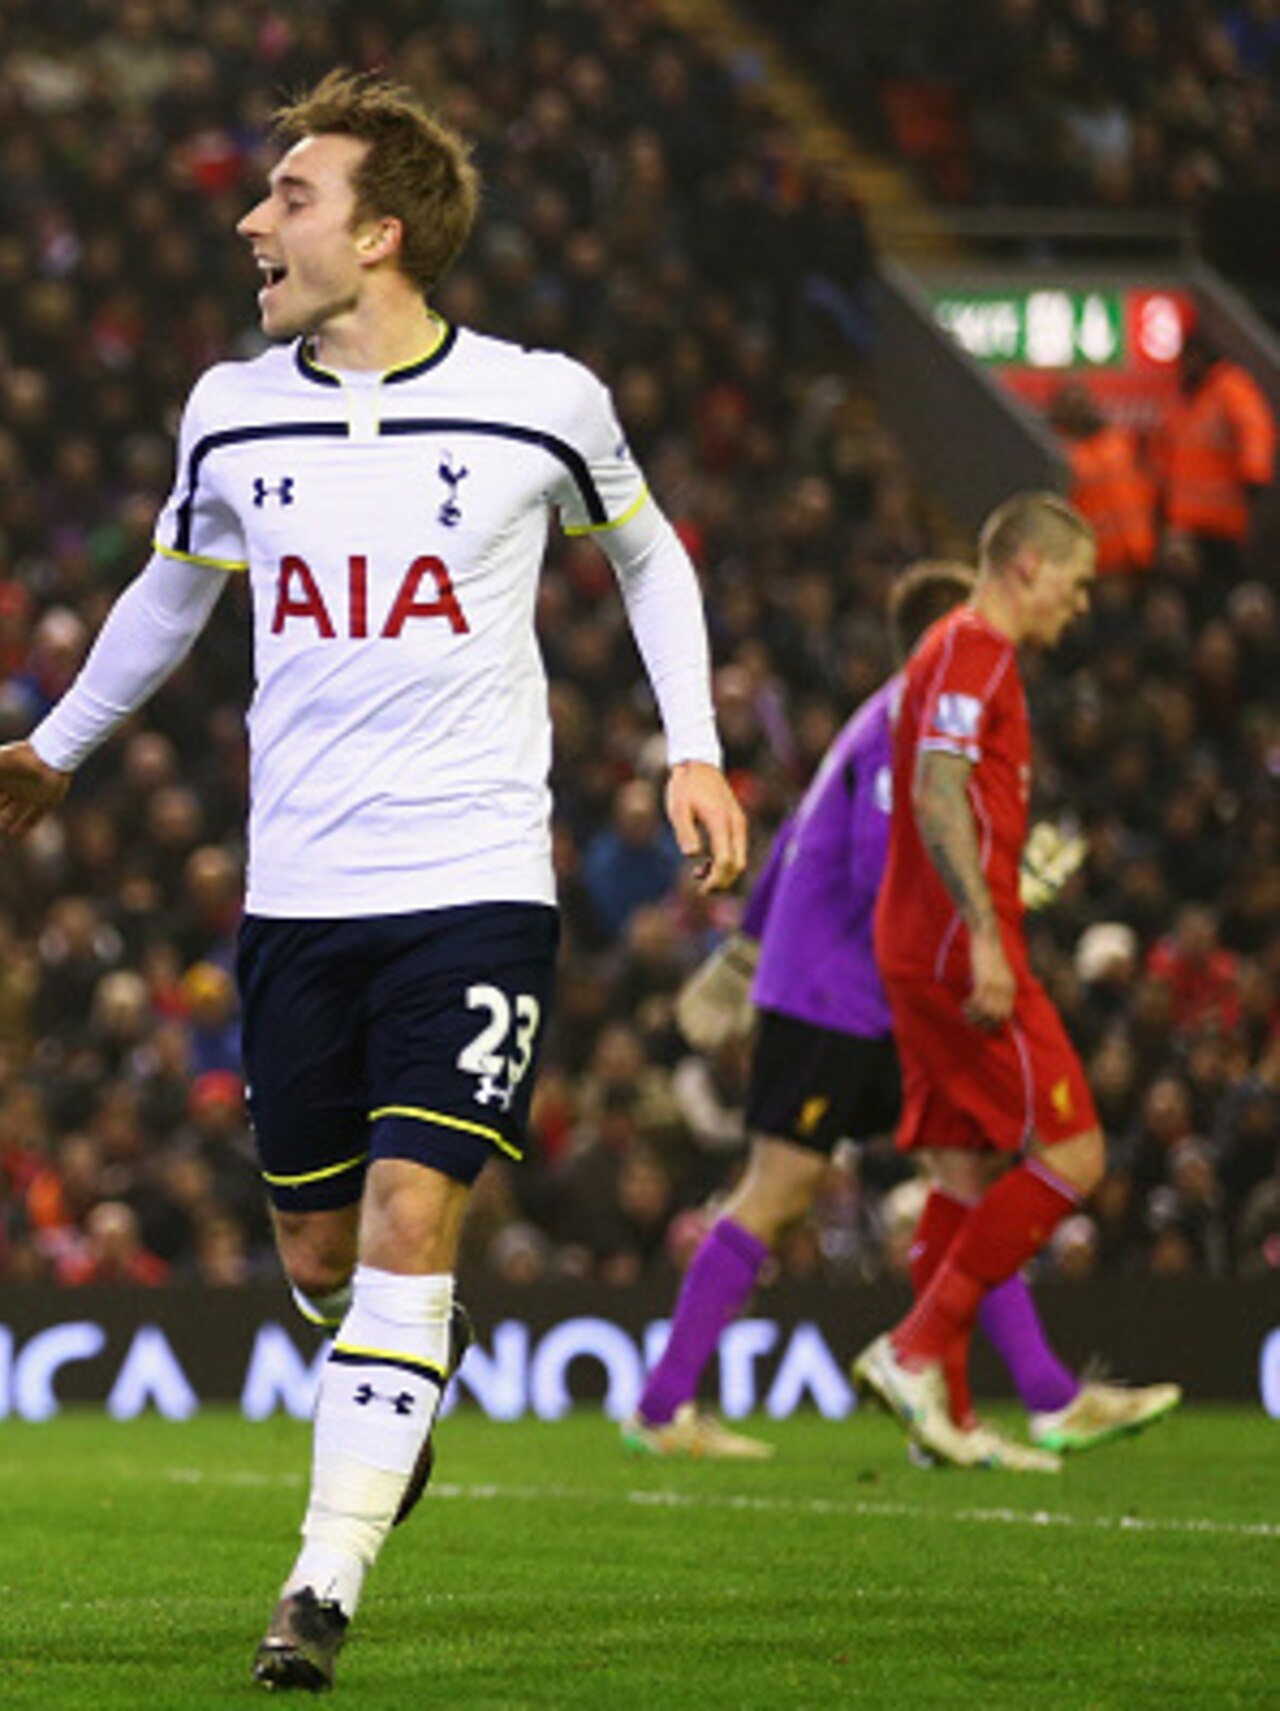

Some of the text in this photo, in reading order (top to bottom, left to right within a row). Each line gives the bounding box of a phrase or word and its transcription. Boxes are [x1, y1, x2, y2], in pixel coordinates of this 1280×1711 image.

[271, 555, 470, 639] AIA
[456, 982, 540, 1085] 23
[240, 1317, 857, 1423] MNOTA
